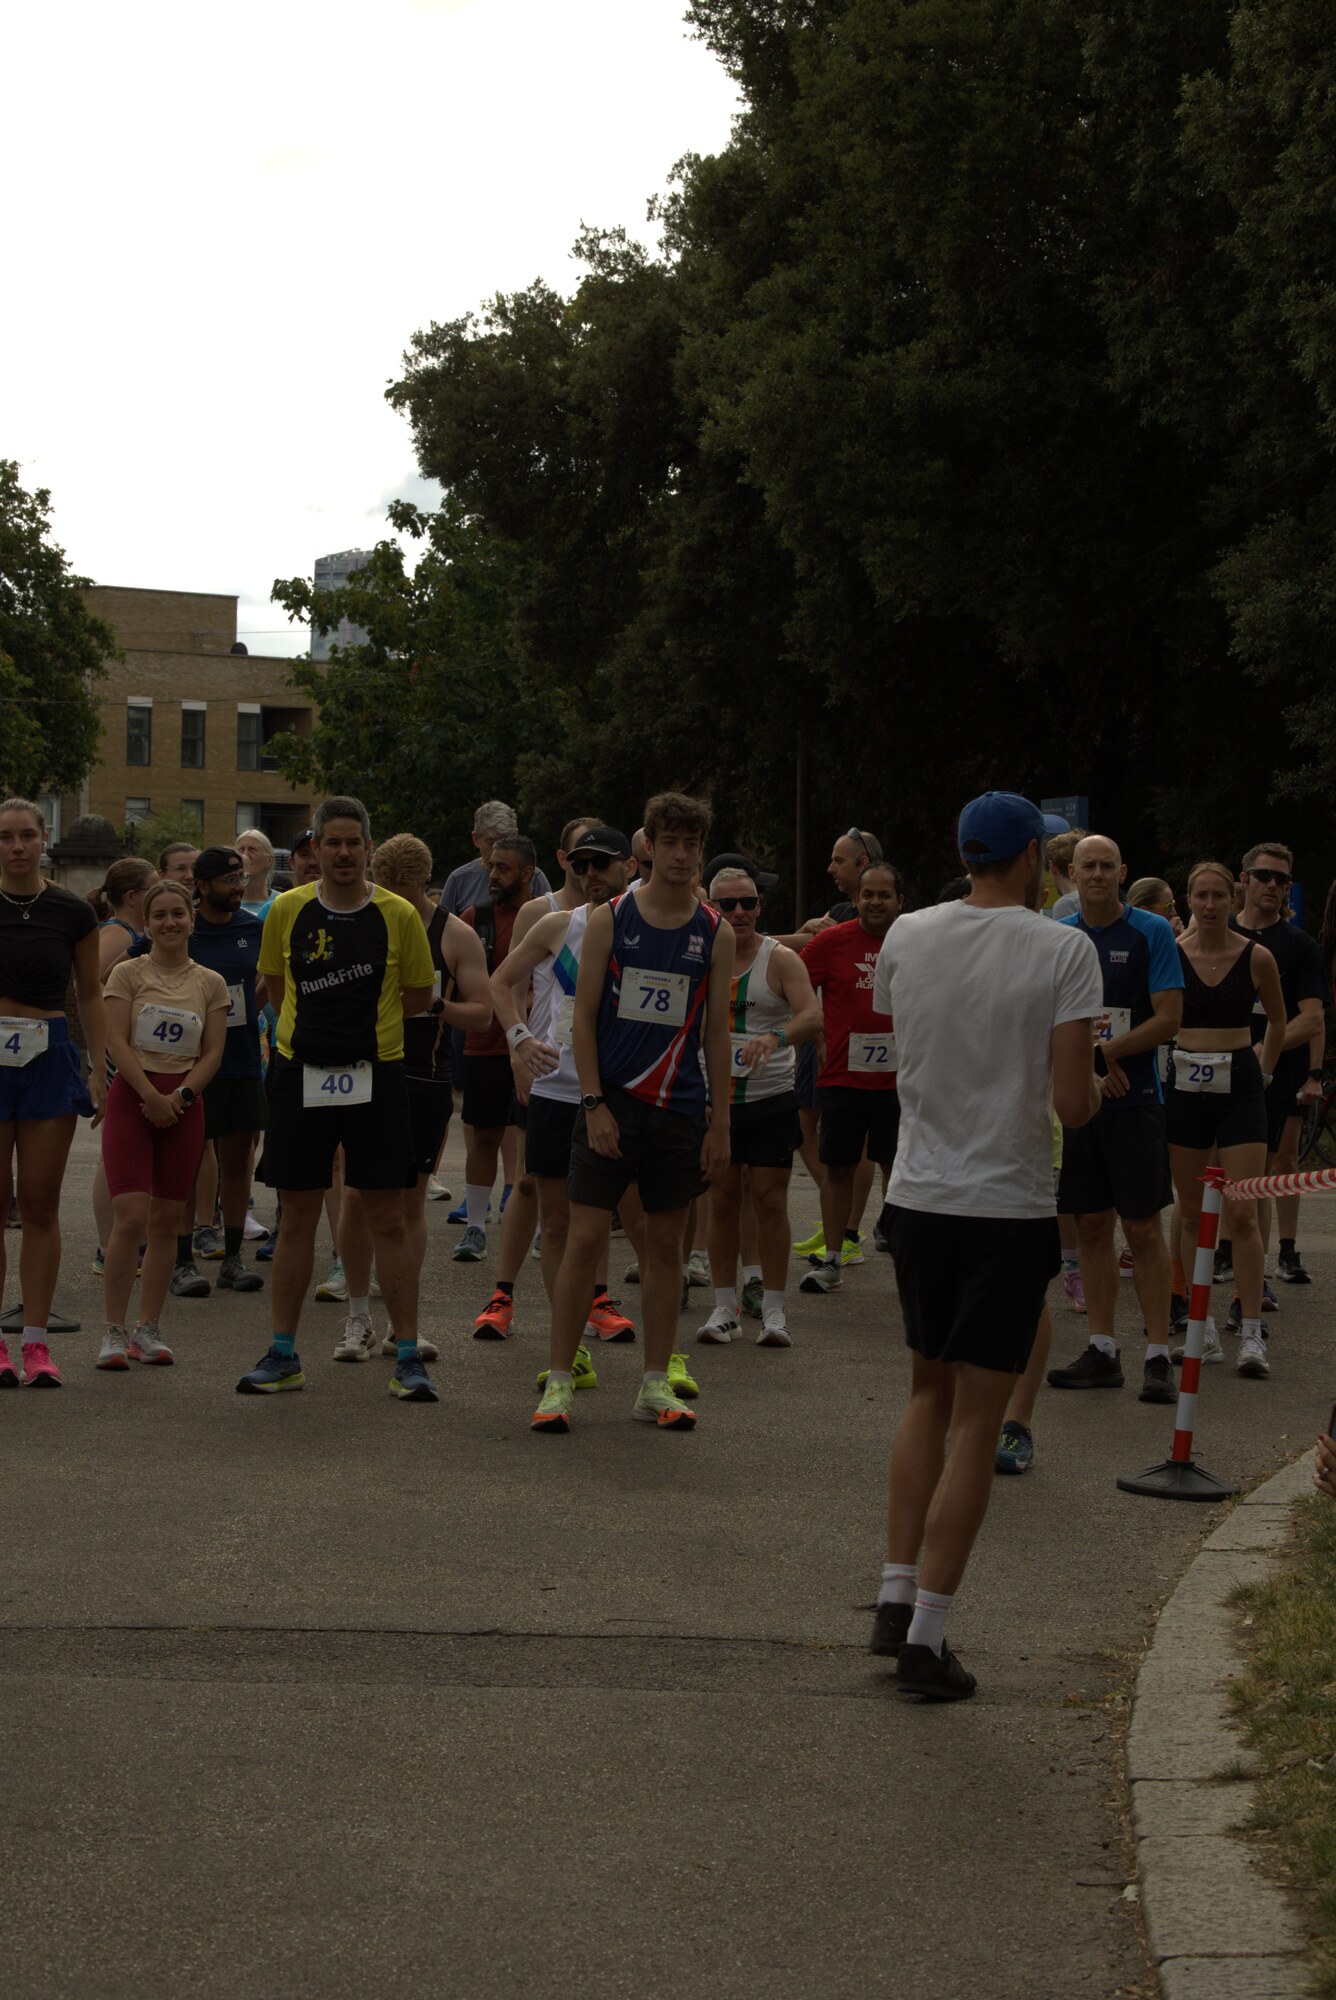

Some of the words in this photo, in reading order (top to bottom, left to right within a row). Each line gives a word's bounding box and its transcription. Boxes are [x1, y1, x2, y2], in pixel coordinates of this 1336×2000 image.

[1109, 955, 1128, 964] CLUB
[299, 962, 373, 995] Run&Frite
[639, 986, 671, 1012] 78
[152, 1021, 184, 1043] 49
[1100, 1022, 1113, 1041] 4
[4, 1032, 21, 1054] 4
[735, 1048, 746, 1067] 6
[863, 1045, 888, 1063] 72
[1189, 1063, 1214, 1083] 29
[321, 1073, 354, 1095] 40
